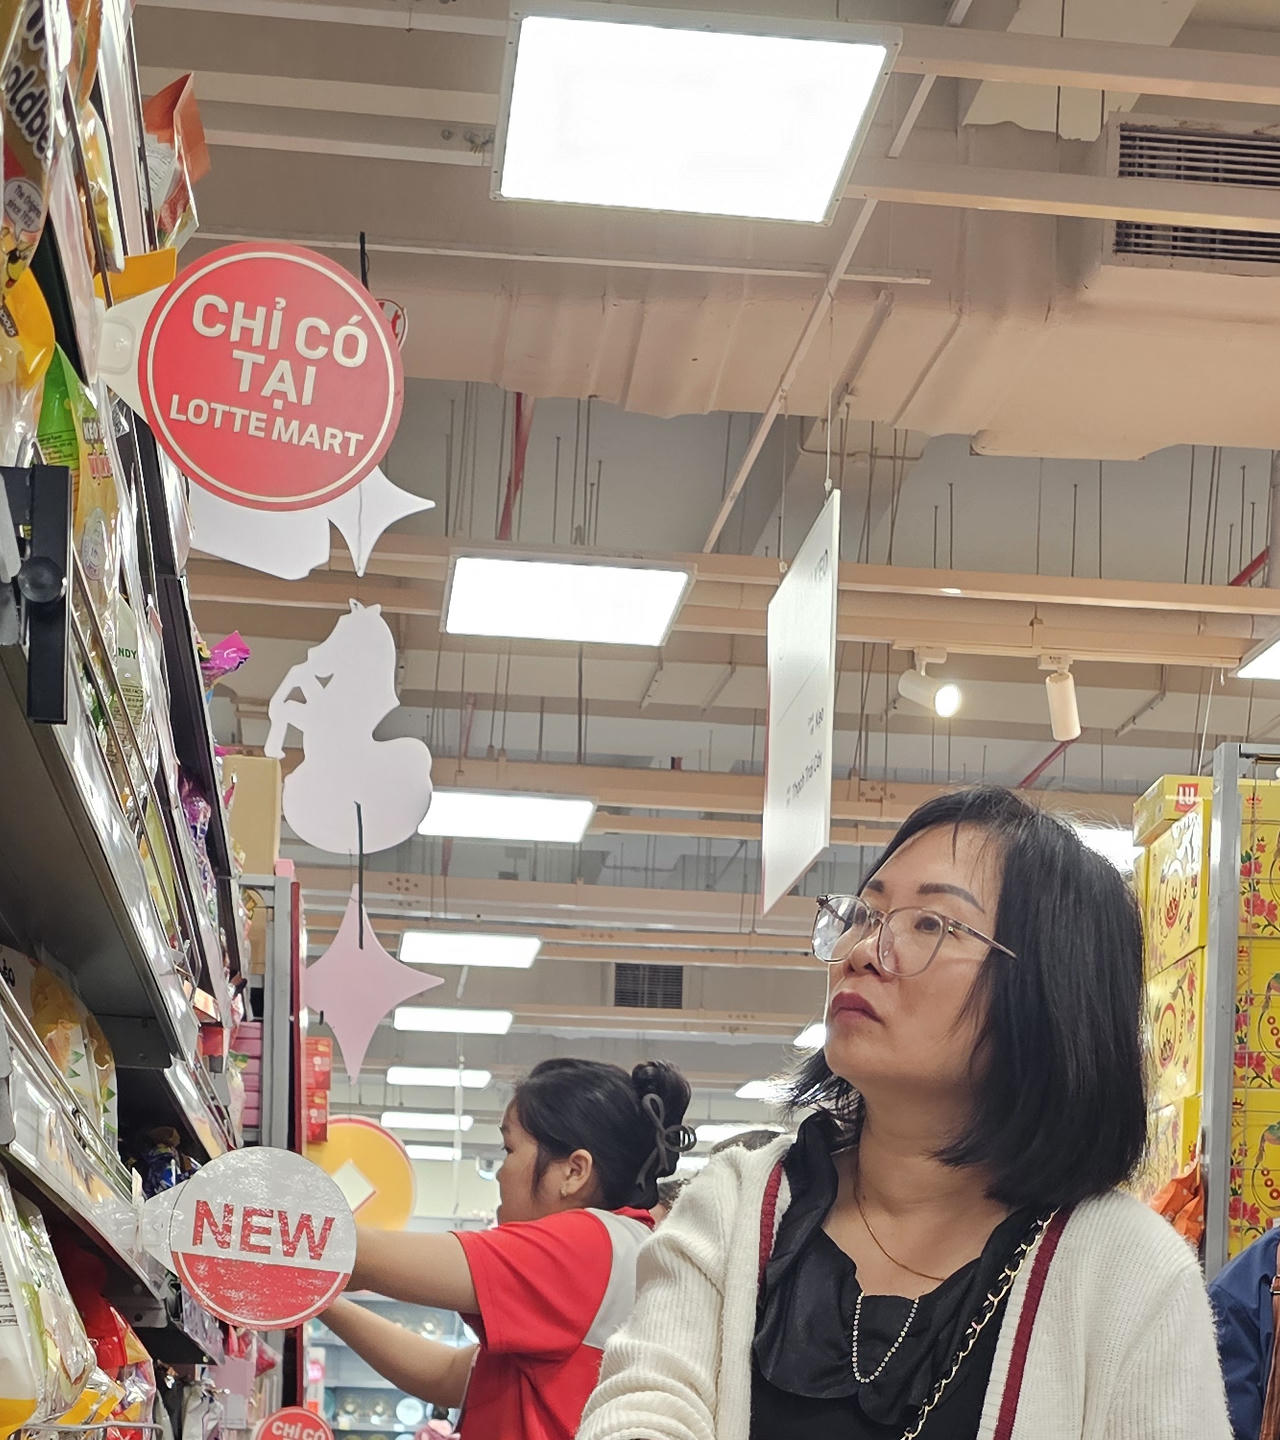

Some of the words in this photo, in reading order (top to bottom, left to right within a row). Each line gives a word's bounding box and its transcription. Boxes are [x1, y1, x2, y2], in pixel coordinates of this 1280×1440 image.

[192, 294, 287, 351] CHỈ
[295, 315, 369, 368] CÓ
[232, 349, 317, 411] TẠI
[169, 393, 268, 439] LOTTE
[271, 415, 365, 458] MART
[192, 1199, 336, 1261] NEW
